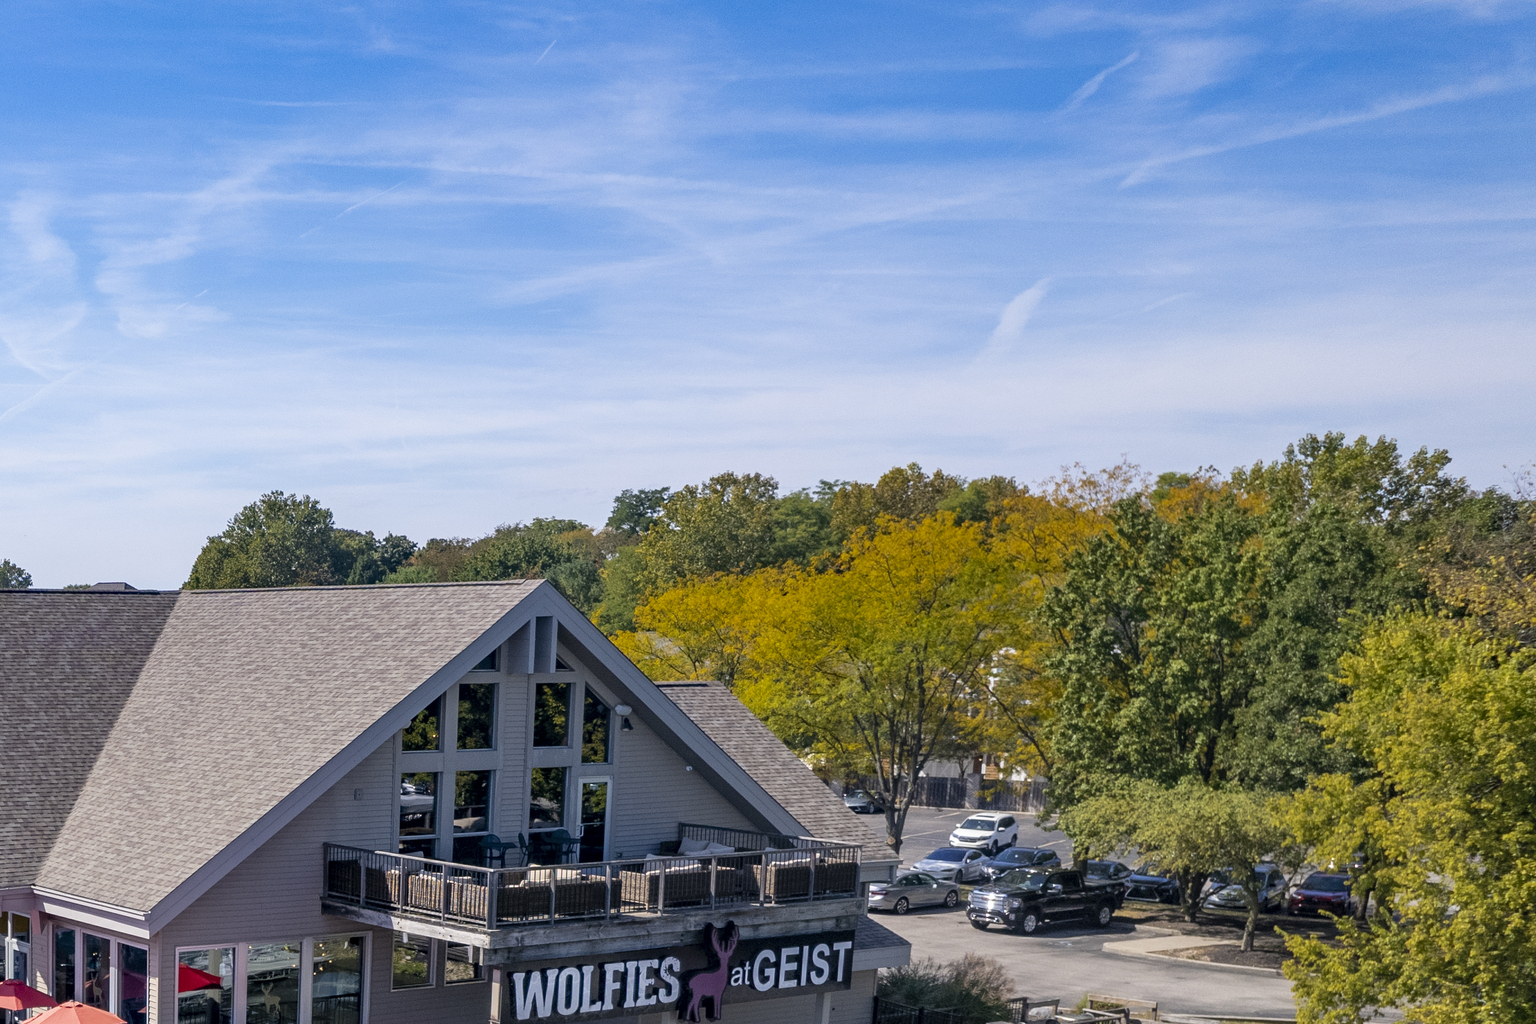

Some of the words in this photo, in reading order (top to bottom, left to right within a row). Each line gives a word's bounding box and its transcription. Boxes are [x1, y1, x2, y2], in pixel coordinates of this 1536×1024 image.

[513, 956, 681, 1021] WOLFIES
[730, 961, 751, 986] at
[752, 940, 852, 992] GEIST
